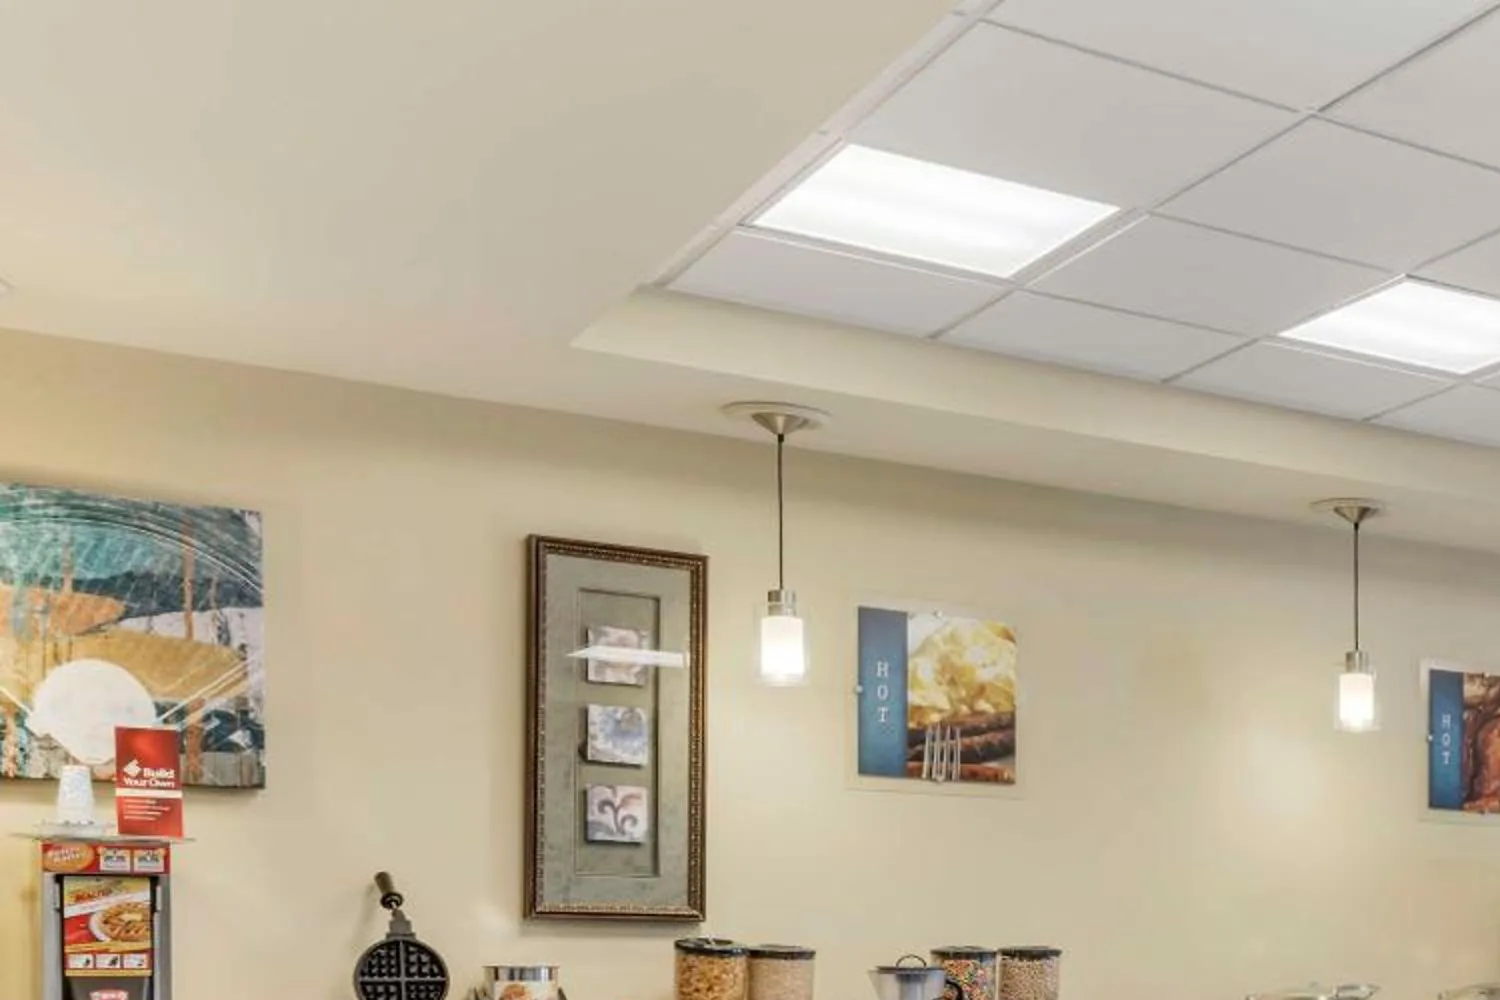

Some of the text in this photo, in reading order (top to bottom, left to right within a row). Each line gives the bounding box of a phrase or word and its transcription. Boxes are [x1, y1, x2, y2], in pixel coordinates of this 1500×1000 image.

[877, 661, 889, 722] HOT
[1441, 713, 1451, 765] HOT
[123, 776, 175, 789] Your Own
[143, 767, 175, 779] Build
